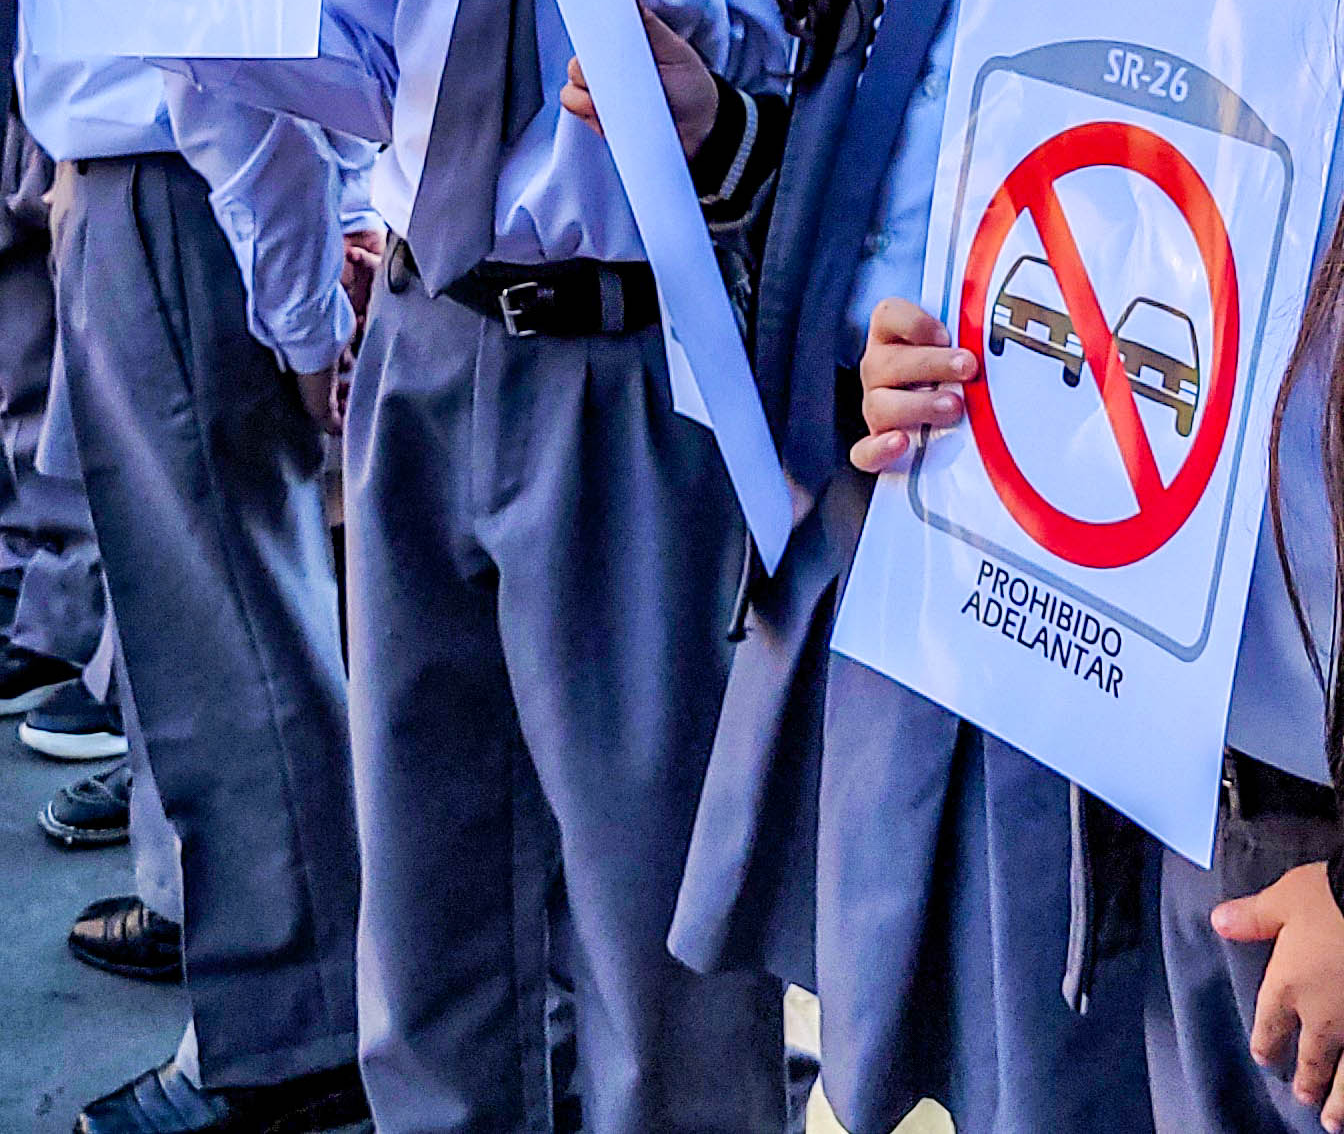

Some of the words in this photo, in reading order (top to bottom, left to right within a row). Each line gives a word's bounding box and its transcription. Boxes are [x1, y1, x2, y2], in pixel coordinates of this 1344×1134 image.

[1103, 48, 1188, 103] SR-26
[961, 590, 1124, 699] ADELANTAR
[977, 558, 1123, 658] PROHIBIDO
